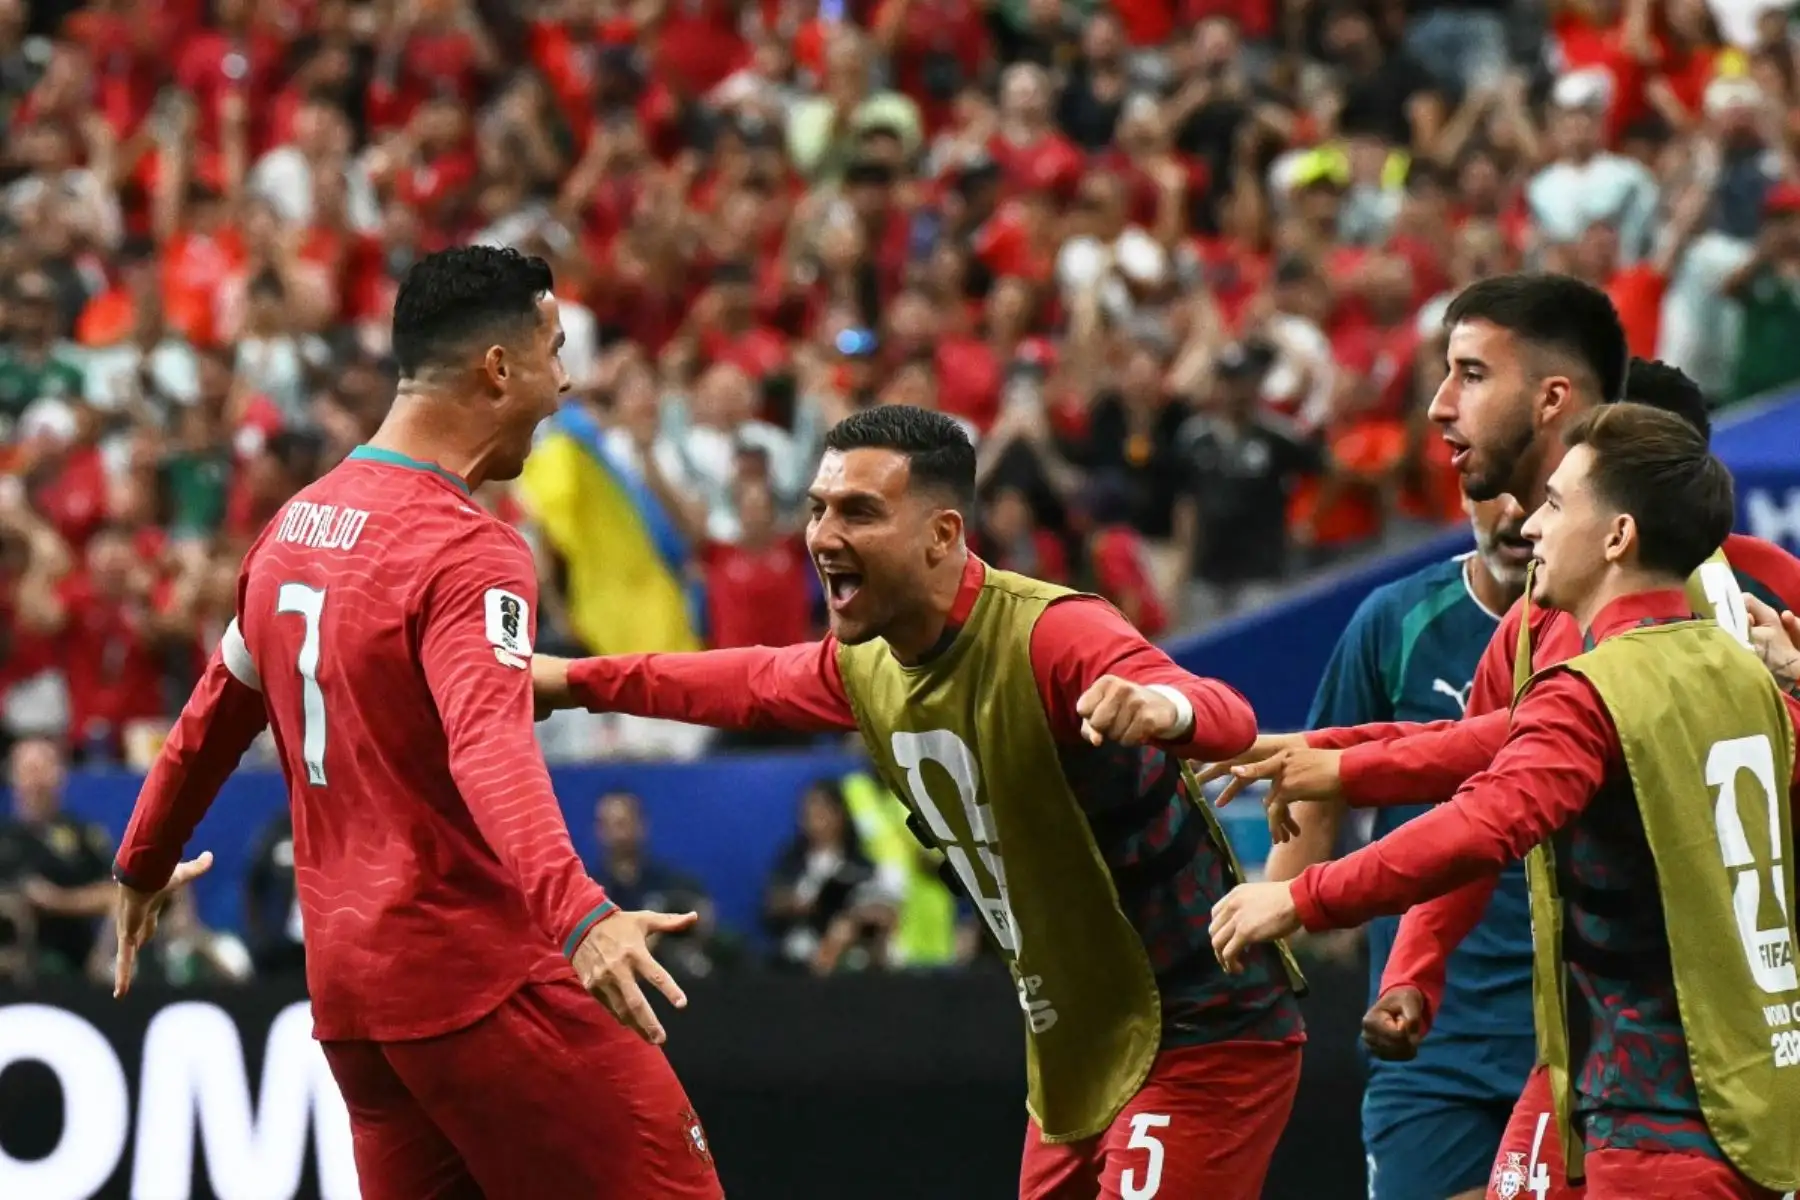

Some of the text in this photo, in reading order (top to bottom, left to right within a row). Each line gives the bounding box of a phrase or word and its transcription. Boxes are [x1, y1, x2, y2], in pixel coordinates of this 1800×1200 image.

[275, 501, 370, 551] RONALDO
[277, 582, 327, 785] 7
[1758, 940, 1794, 969] FIFA
[1120, 1112, 1171, 1200] 5
[1529, 1112, 1550, 1200] 4
